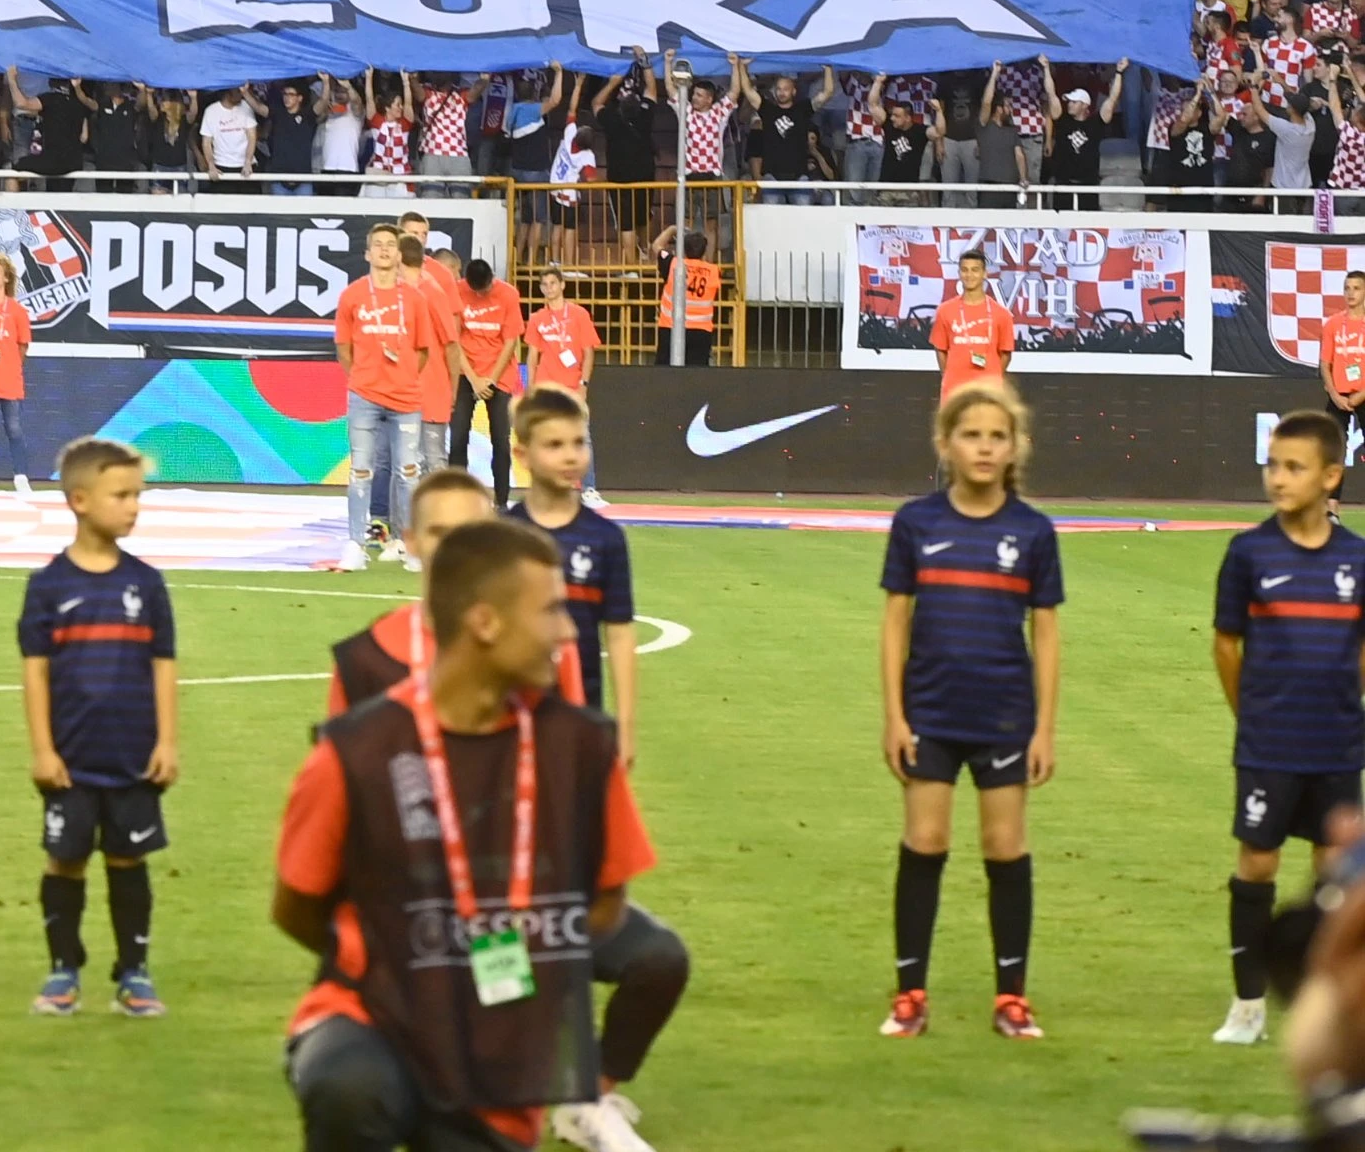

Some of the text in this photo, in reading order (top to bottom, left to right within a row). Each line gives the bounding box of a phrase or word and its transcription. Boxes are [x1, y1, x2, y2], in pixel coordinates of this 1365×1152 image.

[937, 226, 1109, 265] IZNAD
[89, 219, 453, 329] POSUŠ
[957, 271, 1080, 319] VIH
